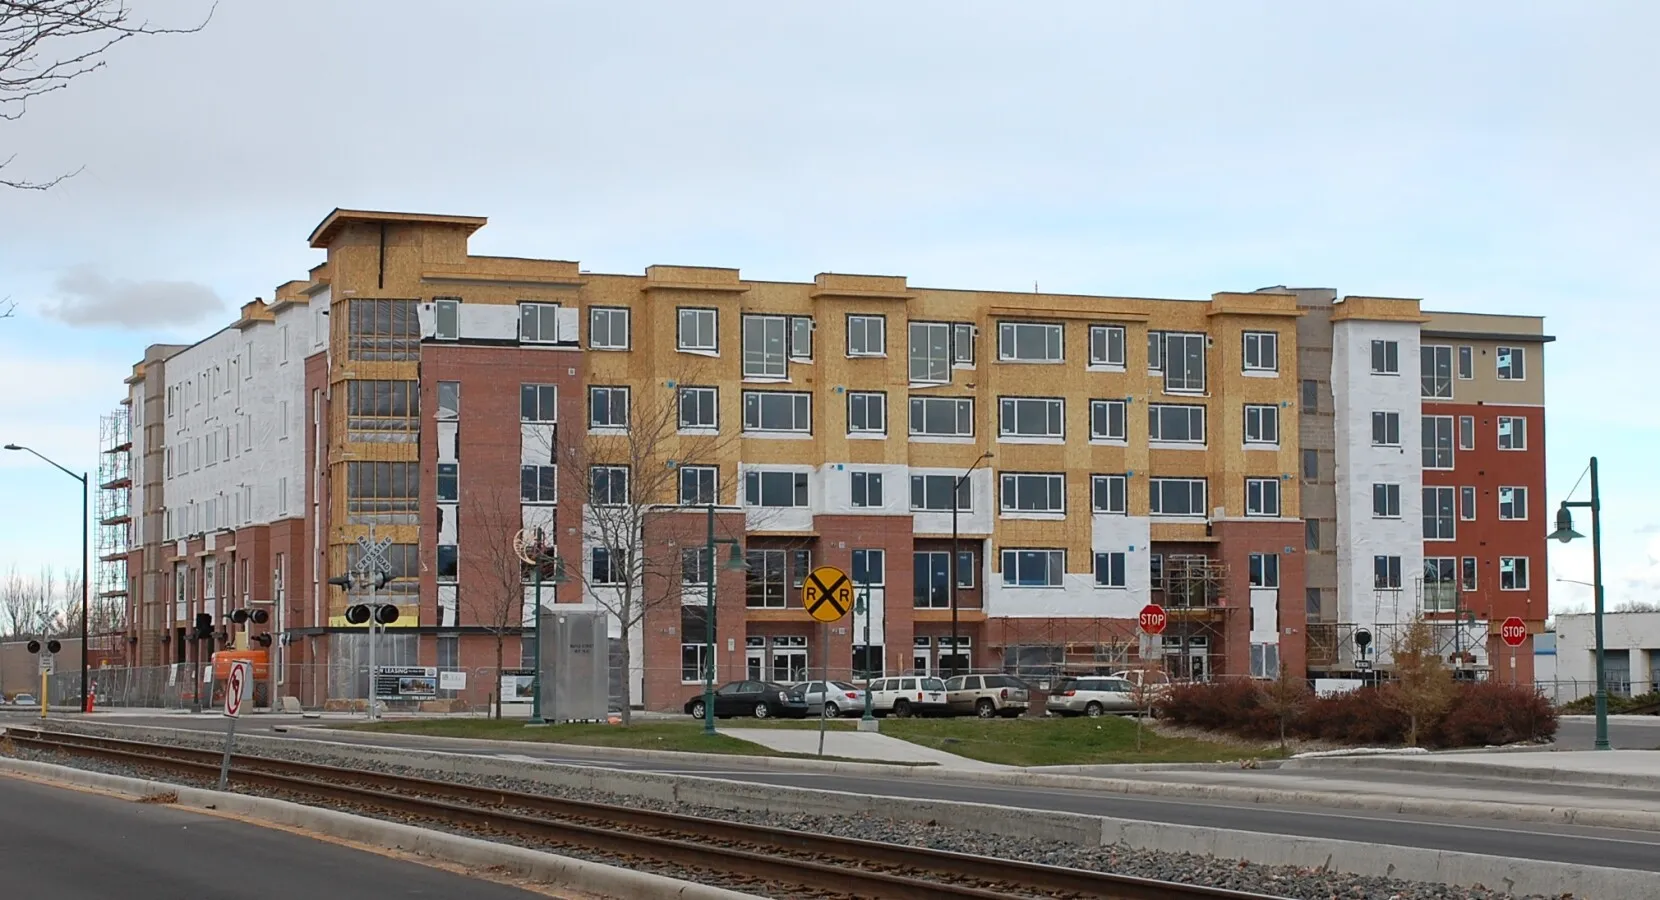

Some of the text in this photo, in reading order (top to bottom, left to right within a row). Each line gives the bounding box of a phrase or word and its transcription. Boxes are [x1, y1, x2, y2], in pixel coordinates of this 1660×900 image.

[357, 536, 391, 569] CROSSING
[806, 587, 849, 602] R R
[1140, 613, 1165, 625] STOP
[1503, 626, 1525, 637] STOP
